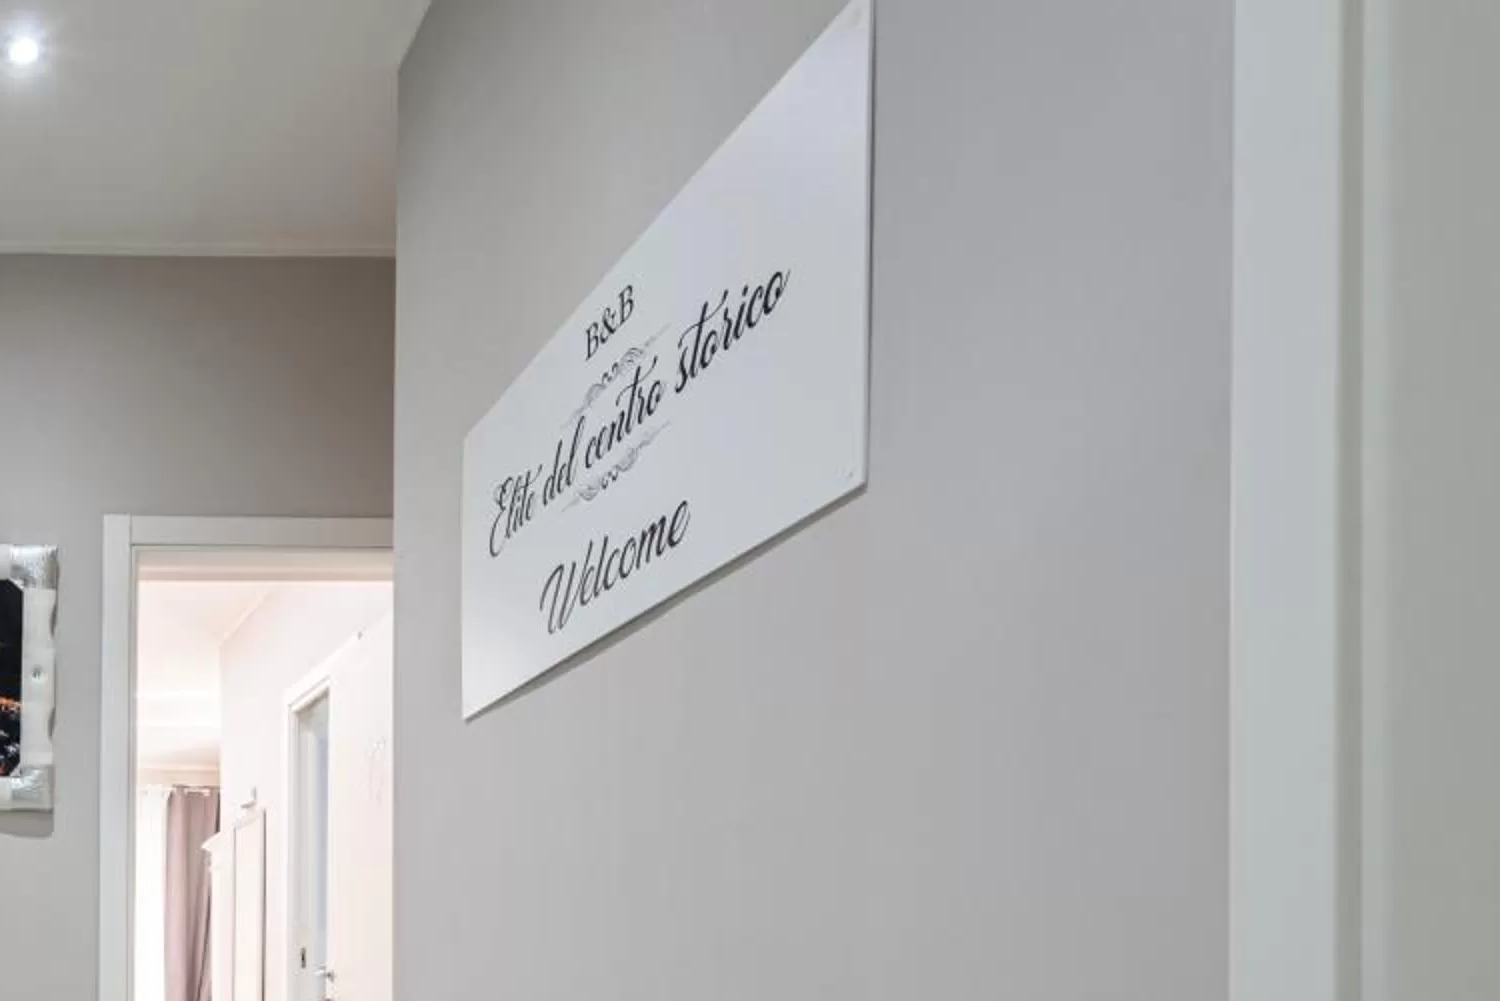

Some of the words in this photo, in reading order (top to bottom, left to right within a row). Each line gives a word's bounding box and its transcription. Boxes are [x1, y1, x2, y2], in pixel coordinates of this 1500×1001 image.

[543, 415, 585, 507] del
[675, 268, 791, 394] storico
[583, 284, 635, 361] B&B
[539, 500, 691, 634] Welcome
